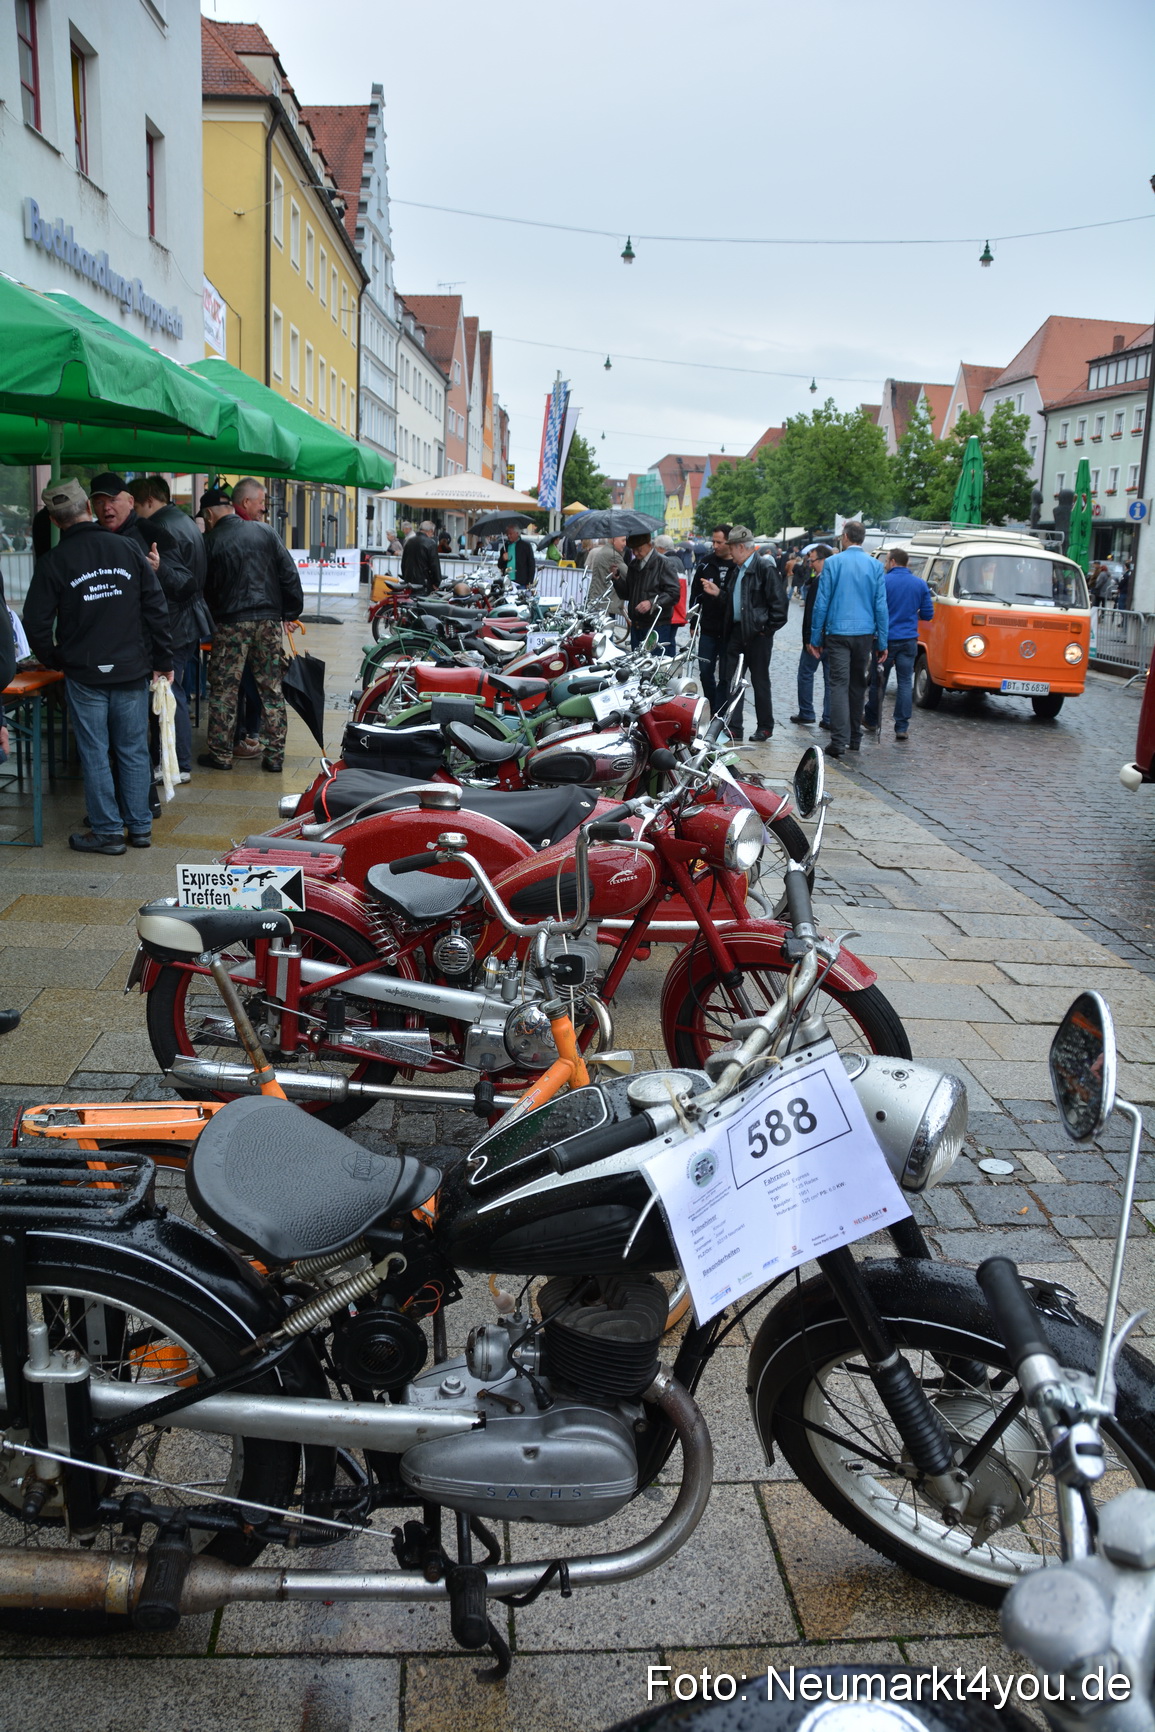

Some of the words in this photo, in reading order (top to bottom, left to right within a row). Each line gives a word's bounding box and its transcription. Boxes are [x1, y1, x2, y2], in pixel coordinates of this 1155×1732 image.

[24, 197, 134, 314] Buchhandlung
[133, 277, 183, 340] Rupprecht
[1007, 682, 1016, 690] BT
[1021, 682, 1031, 692] TS
[1031, 683, 1049, 692] 683H
[182, 869, 240, 890] Express-
[182, 888, 231, 905] Treffen
[748, 1097, 817, 1159] 588
[763, 1169, 791, 1187] Fahrzeug
[853, 1209, 883, 1225] NEUMARKT
[486, 1486, 582, 1499] SACHS
